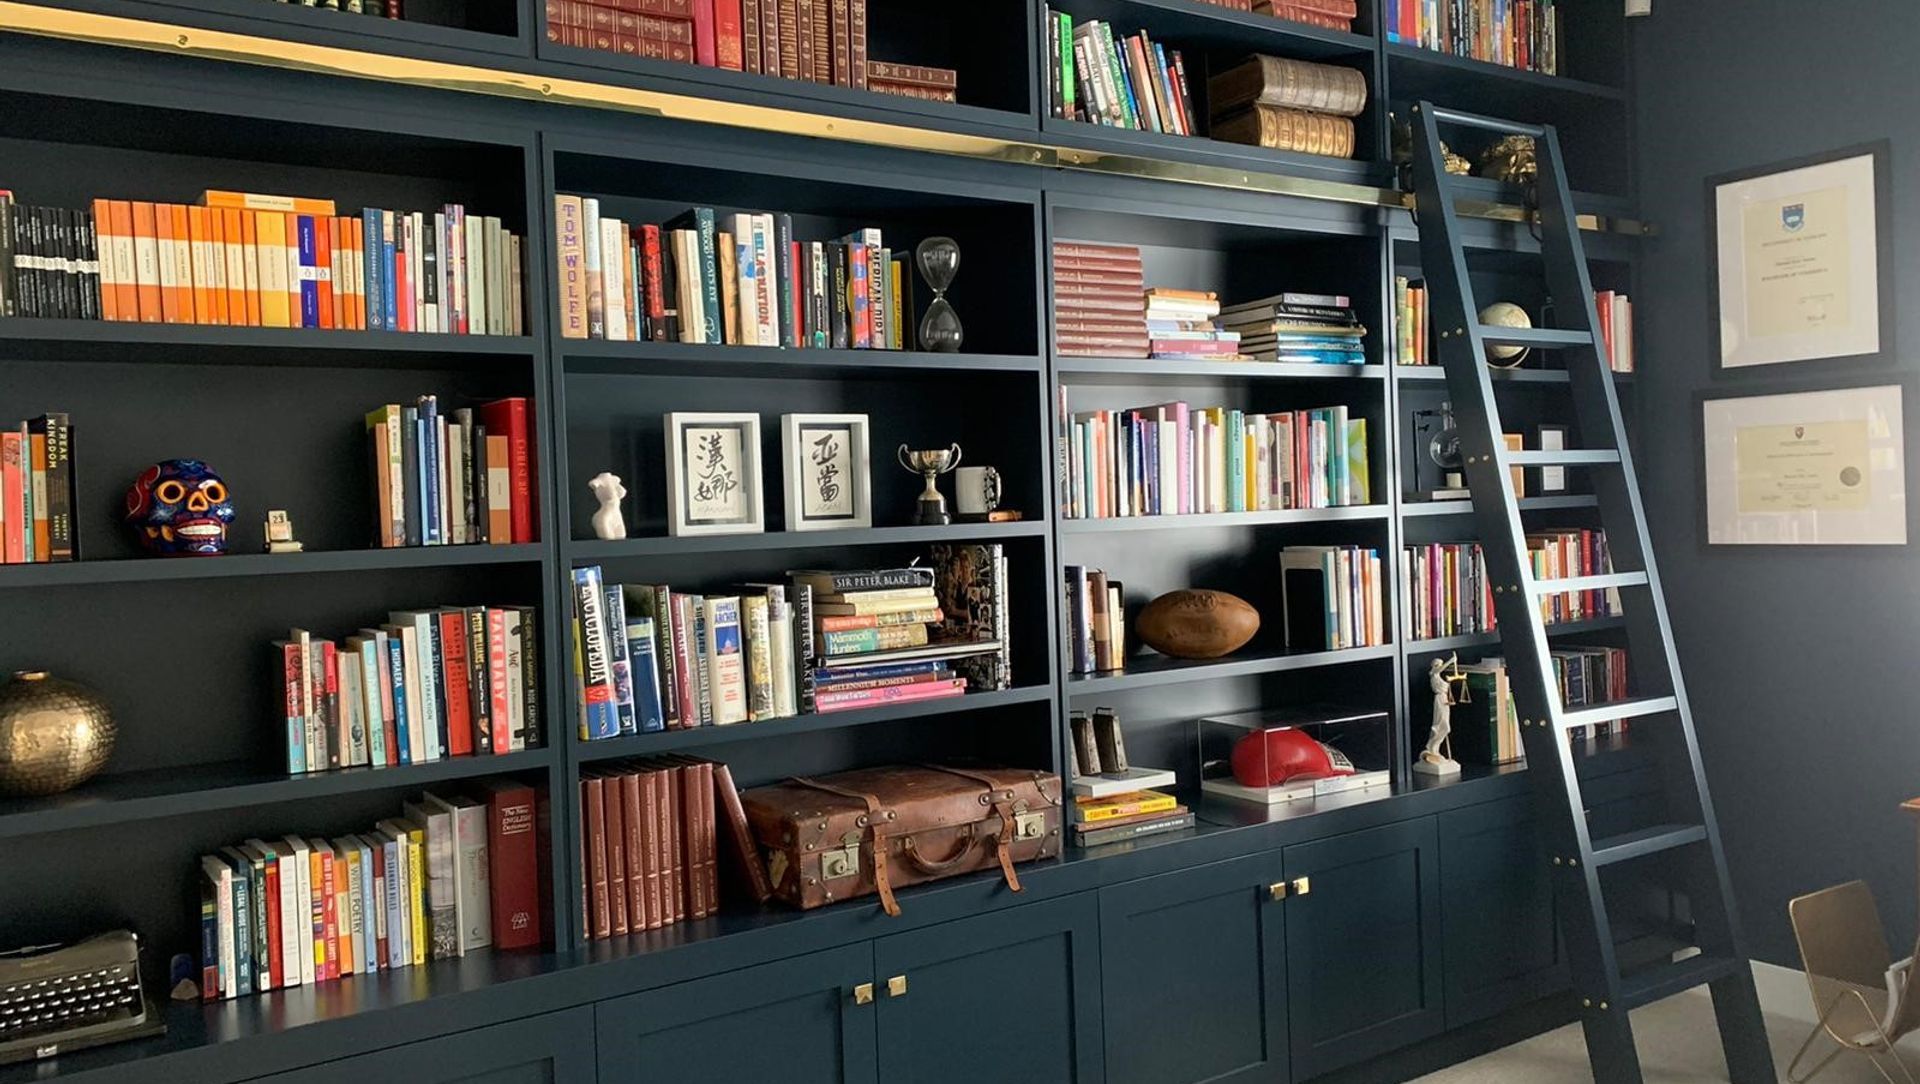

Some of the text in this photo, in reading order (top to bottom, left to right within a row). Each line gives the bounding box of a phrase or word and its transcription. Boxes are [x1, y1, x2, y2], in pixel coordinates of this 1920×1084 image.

[1103, 24, 1114, 55] Puppy
[1110, 59, 1121, 77] Zen
[562, 204, 580, 329] TOM WOLFE
[707, 260, 715, 285] CAT'S
[754, 233, 769, 326] HELLA NATION
[869, 243, 883, 335] AMERICAN DIRT
[47, 419, 56, 469] KINGDOM
[58, 426, 67, 461] FREAK
[837, 575, 910, 588] SIR PETER BLAKE
[608, 595, 622, 658] Alternative Medicine
[660, 604, 668, 626] PRIVATE
[696, 606, 706, 654] mark inglis
[715, 613, 737, 624] ARCHER
[472, 612, 484, 663] PETER WILLIAMS
[491, 614, 503, 653] FAKE
[581, 584, 607, 684] ENCYCLOPEDIA
[830, 632, 872, 643] Mammoth
[830, 644, 861, 655] Hunters
[392, 648, 401, 688] IHIMAERA
[430, 624, 440, 684] False River
[802, 649, 812, 682] BLAKE
[494, 660, 505, 701] BABY
[699, 657, 708, 689] EVEREST
[828, 677, 914, 691] MILLENNIUM MOMENTS
[425, 675, 433, 720] ATTRACTION
[502, 815, 532, 825] ENGLISH
[502, 823, 532, 831] Dictionary
[505, 809, 515, 817] The
[324, 858, 332, 872] BIRD
[409, 849, 417, 884] ATWOOD
[237, 890, 245, 908] LEGAL
[351, 866, 362, 934] WRITE POETRY
[387, 862, 397, 911] GRAMMAR RULES
[238, 909, 246, 927] GUIDE
